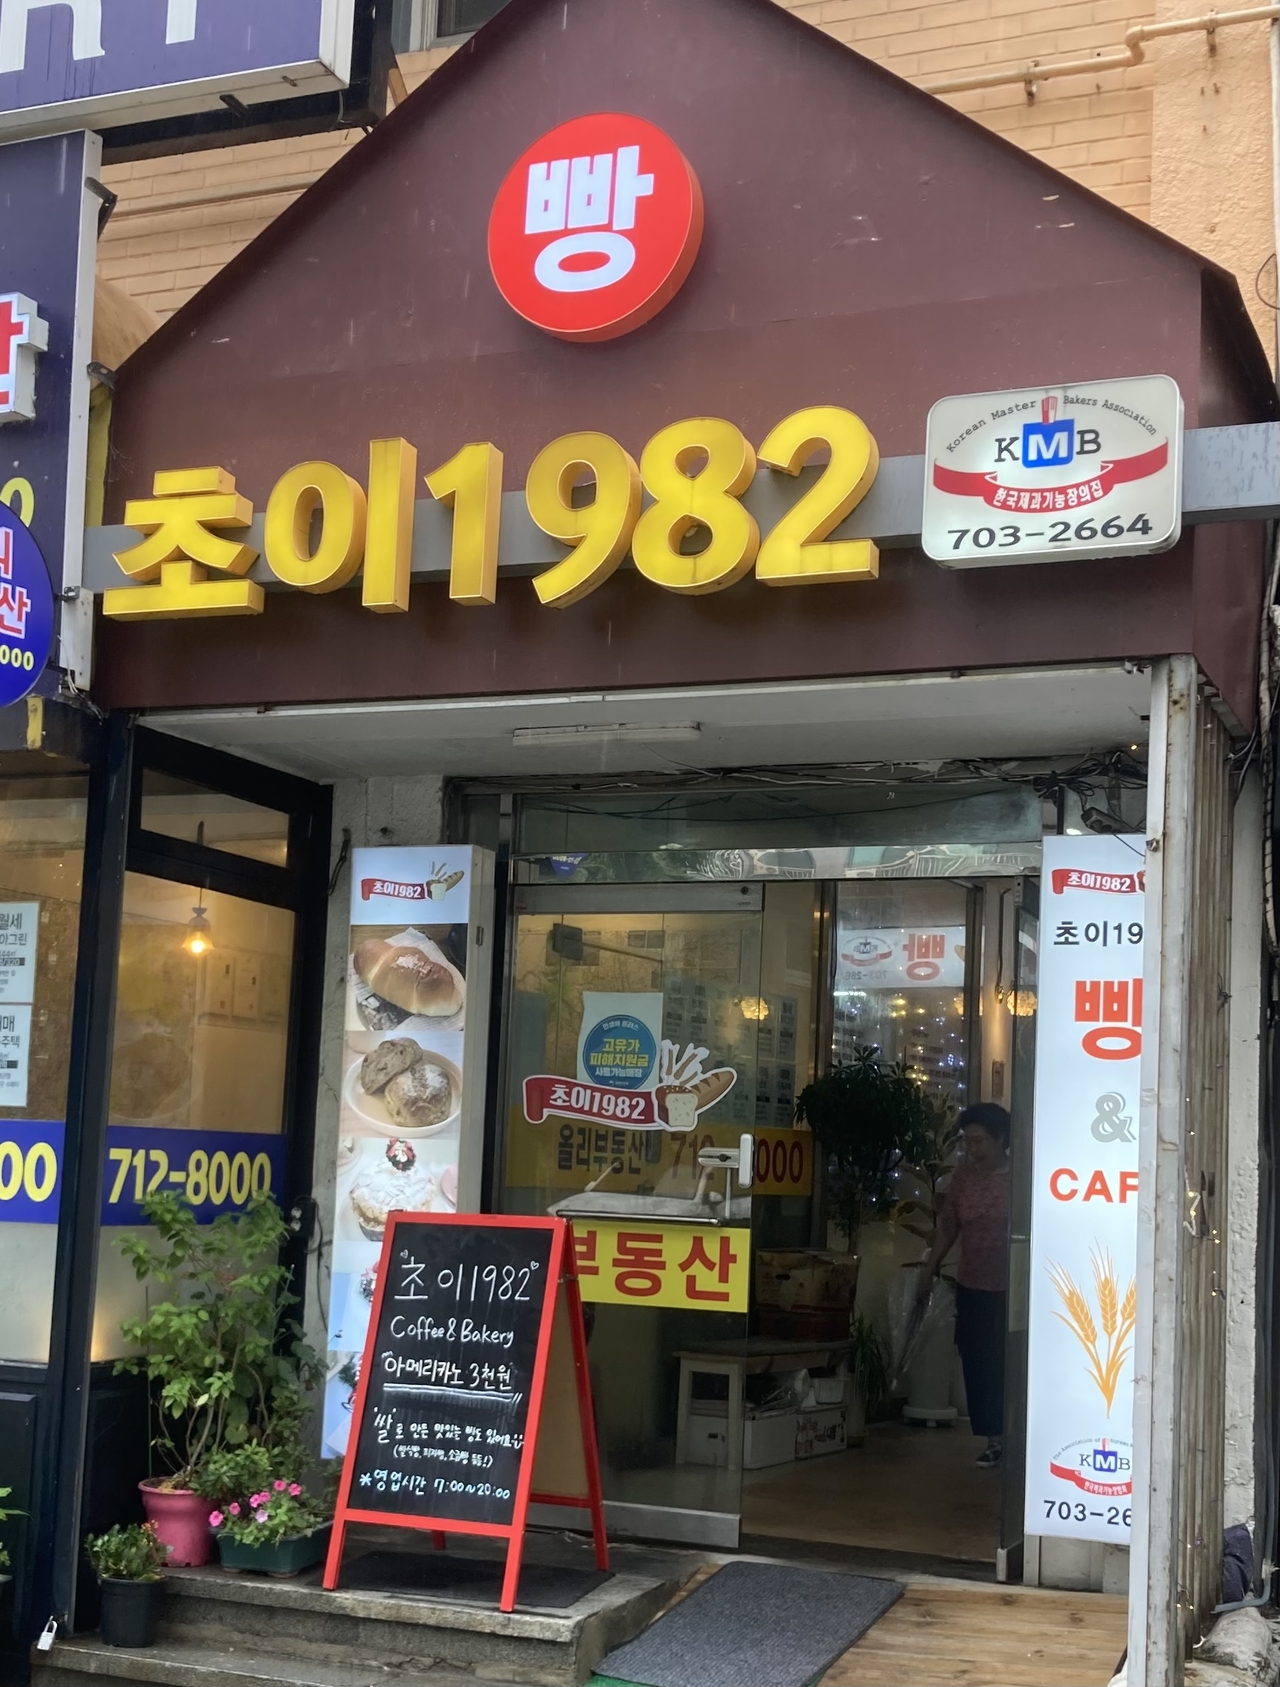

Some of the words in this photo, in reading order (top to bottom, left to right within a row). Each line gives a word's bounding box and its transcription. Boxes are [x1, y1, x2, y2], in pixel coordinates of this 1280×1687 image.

[525, 145, 655, 292] 빵
[946, 419, 987, 453] Korean
[990, 400, 1037, 420] Master
[1062, 395, 1098, 406] Bakers
[1101, 400, 1157, 436] Association
[994, 429, 1101, 463] KMB
[993, 480, 1104, 509] 한국제과기능장의집
[102, 405, 879, 621] 초이1982
[947, 513, 1153, 550] 703-2664
[373, 881, 422, 898] 초이1982
[1067, 871, 1131, 891] 초이1982
[590, 1053, 650, 1067] 피해지원금
[603, 1039, 640, 1052] 고유가
[549, 1084, 645, 1119] 초이1982
[108, 1147, 271, 1205] 712-8000
[384, 1356, 464, 1384] 아메리카노
[470, 1363, 513, 1389] 3천원
[434, 1423, 462, 1441] 맛있는
[465, 1425, 482, 1443] 빵도
